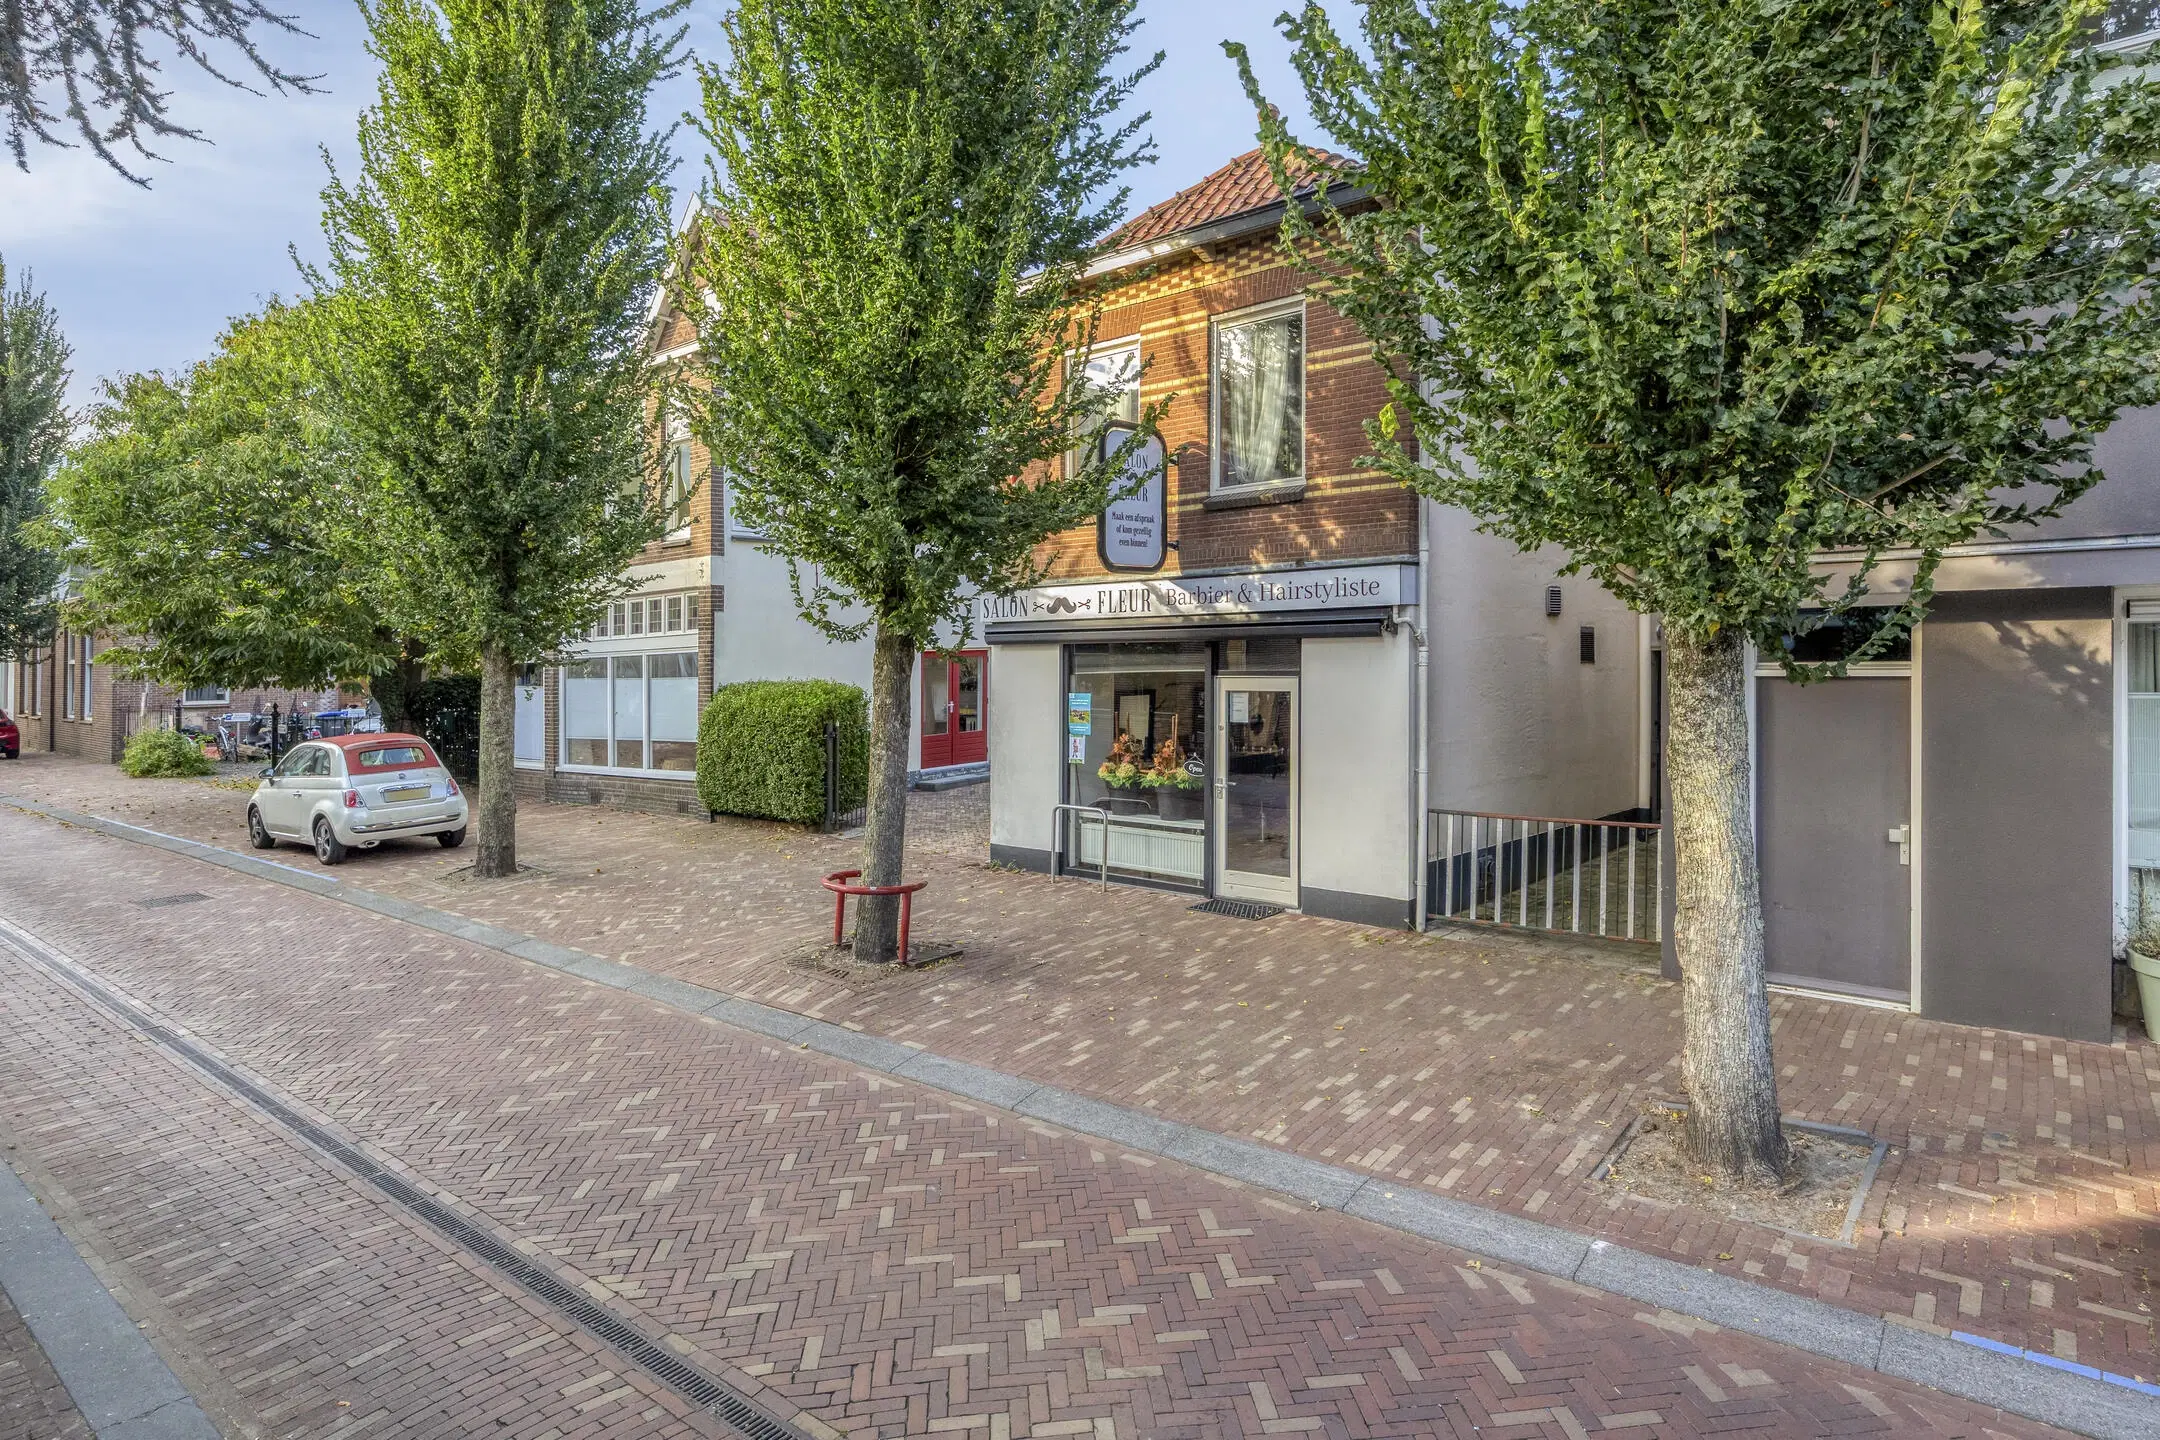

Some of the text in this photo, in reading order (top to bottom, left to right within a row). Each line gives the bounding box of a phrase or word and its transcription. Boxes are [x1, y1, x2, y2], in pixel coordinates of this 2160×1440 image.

[1112, 512, 1155, 525] Maak een afspraak
[1116, 524, 1152, 538] of kom gezellig
[983, 576, 1381, 619] SALON FLEUR Barbier & Hairstyliste
[1189, 764, 1202, 773] Open
